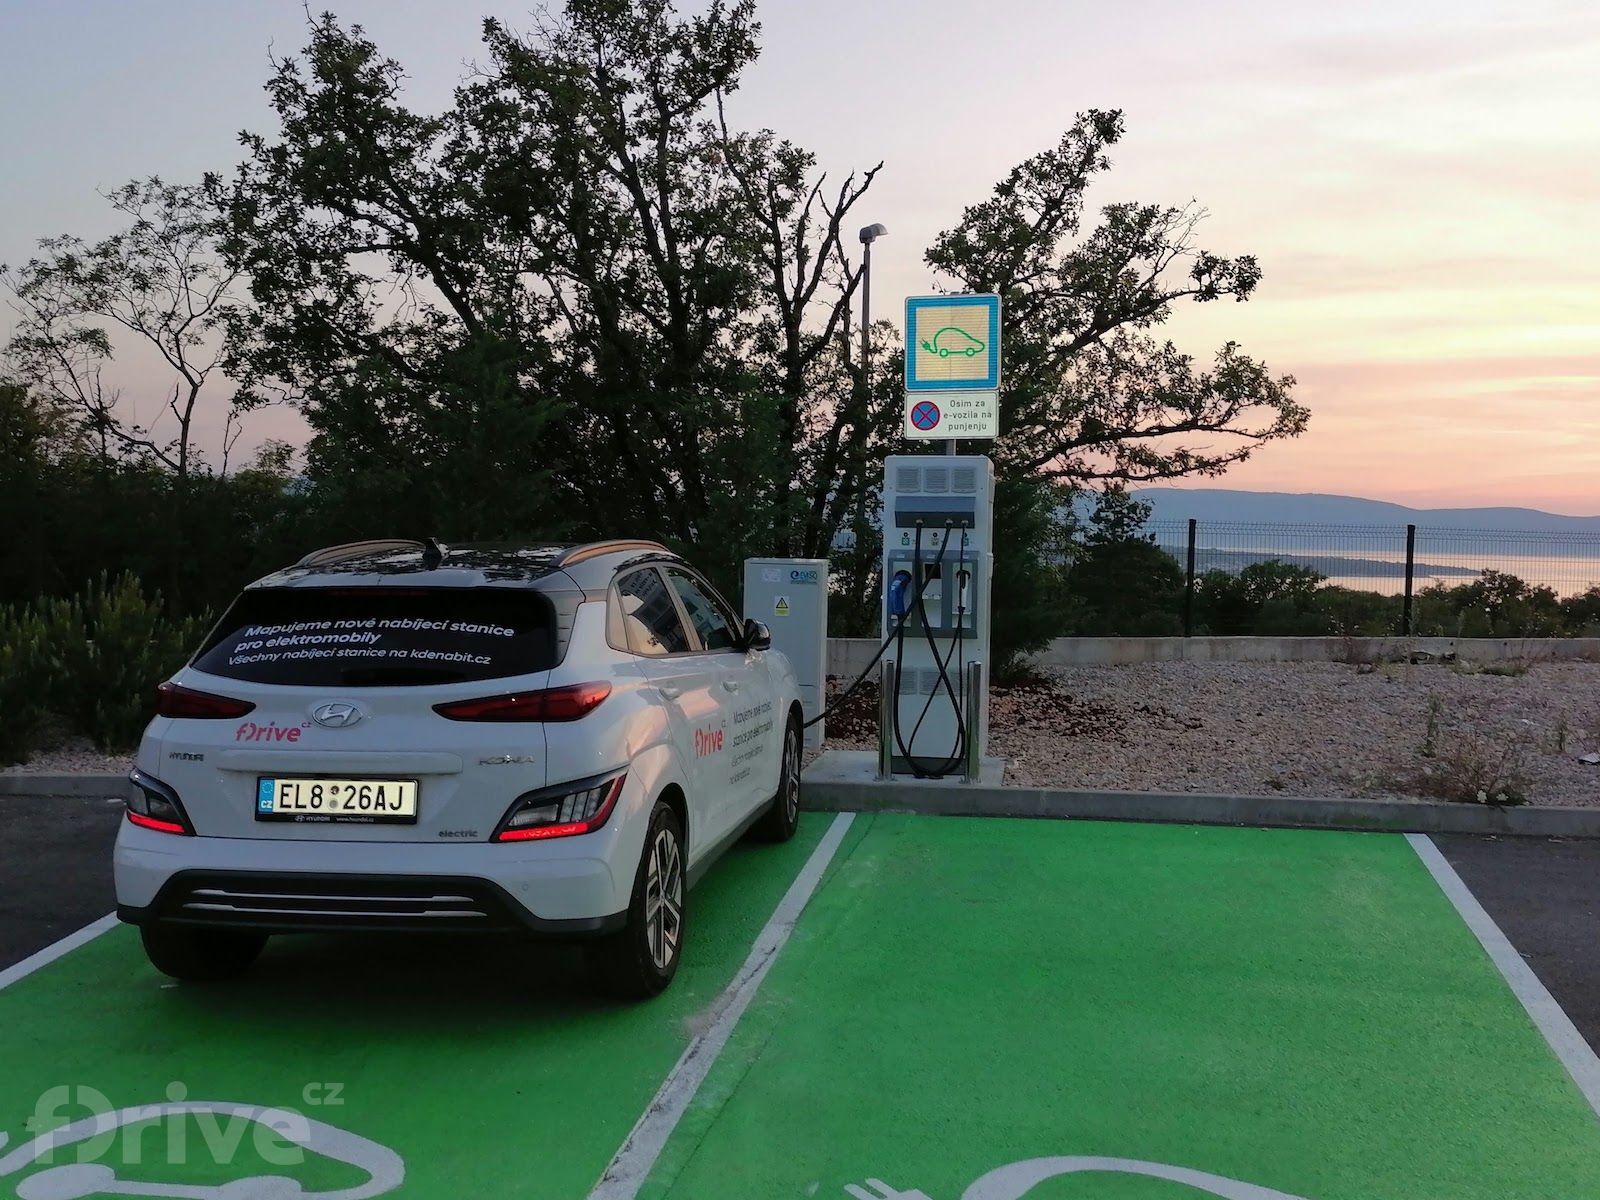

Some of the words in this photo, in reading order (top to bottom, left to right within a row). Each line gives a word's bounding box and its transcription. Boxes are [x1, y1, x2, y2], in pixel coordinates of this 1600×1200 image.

[943, 410, 978, 419] e-vozila
[948, 422, 987, 432] punjenju
[244, 621, 332, 638] Mapujeme
[333, 617, 377, 630] nové
[378, 618, 450, 631] nabíjecí
[450, 619, 515, 637] stanice
[234, 640, 263, 654] pro
[265, 632, 382, 647] elektromobily
[228, 652, 281, 665] Všechny
[336, 647, 387, 658] stanice
[388, 649, 408, 658] na
[409, 649, 492, 665] kdenabit.cz
[260, 800, 273, 809] CZ
[279, 783, 324, 809] EL8
[342, 784, 403, 811] 26AJ
[438, 830, 478, 838] electric
